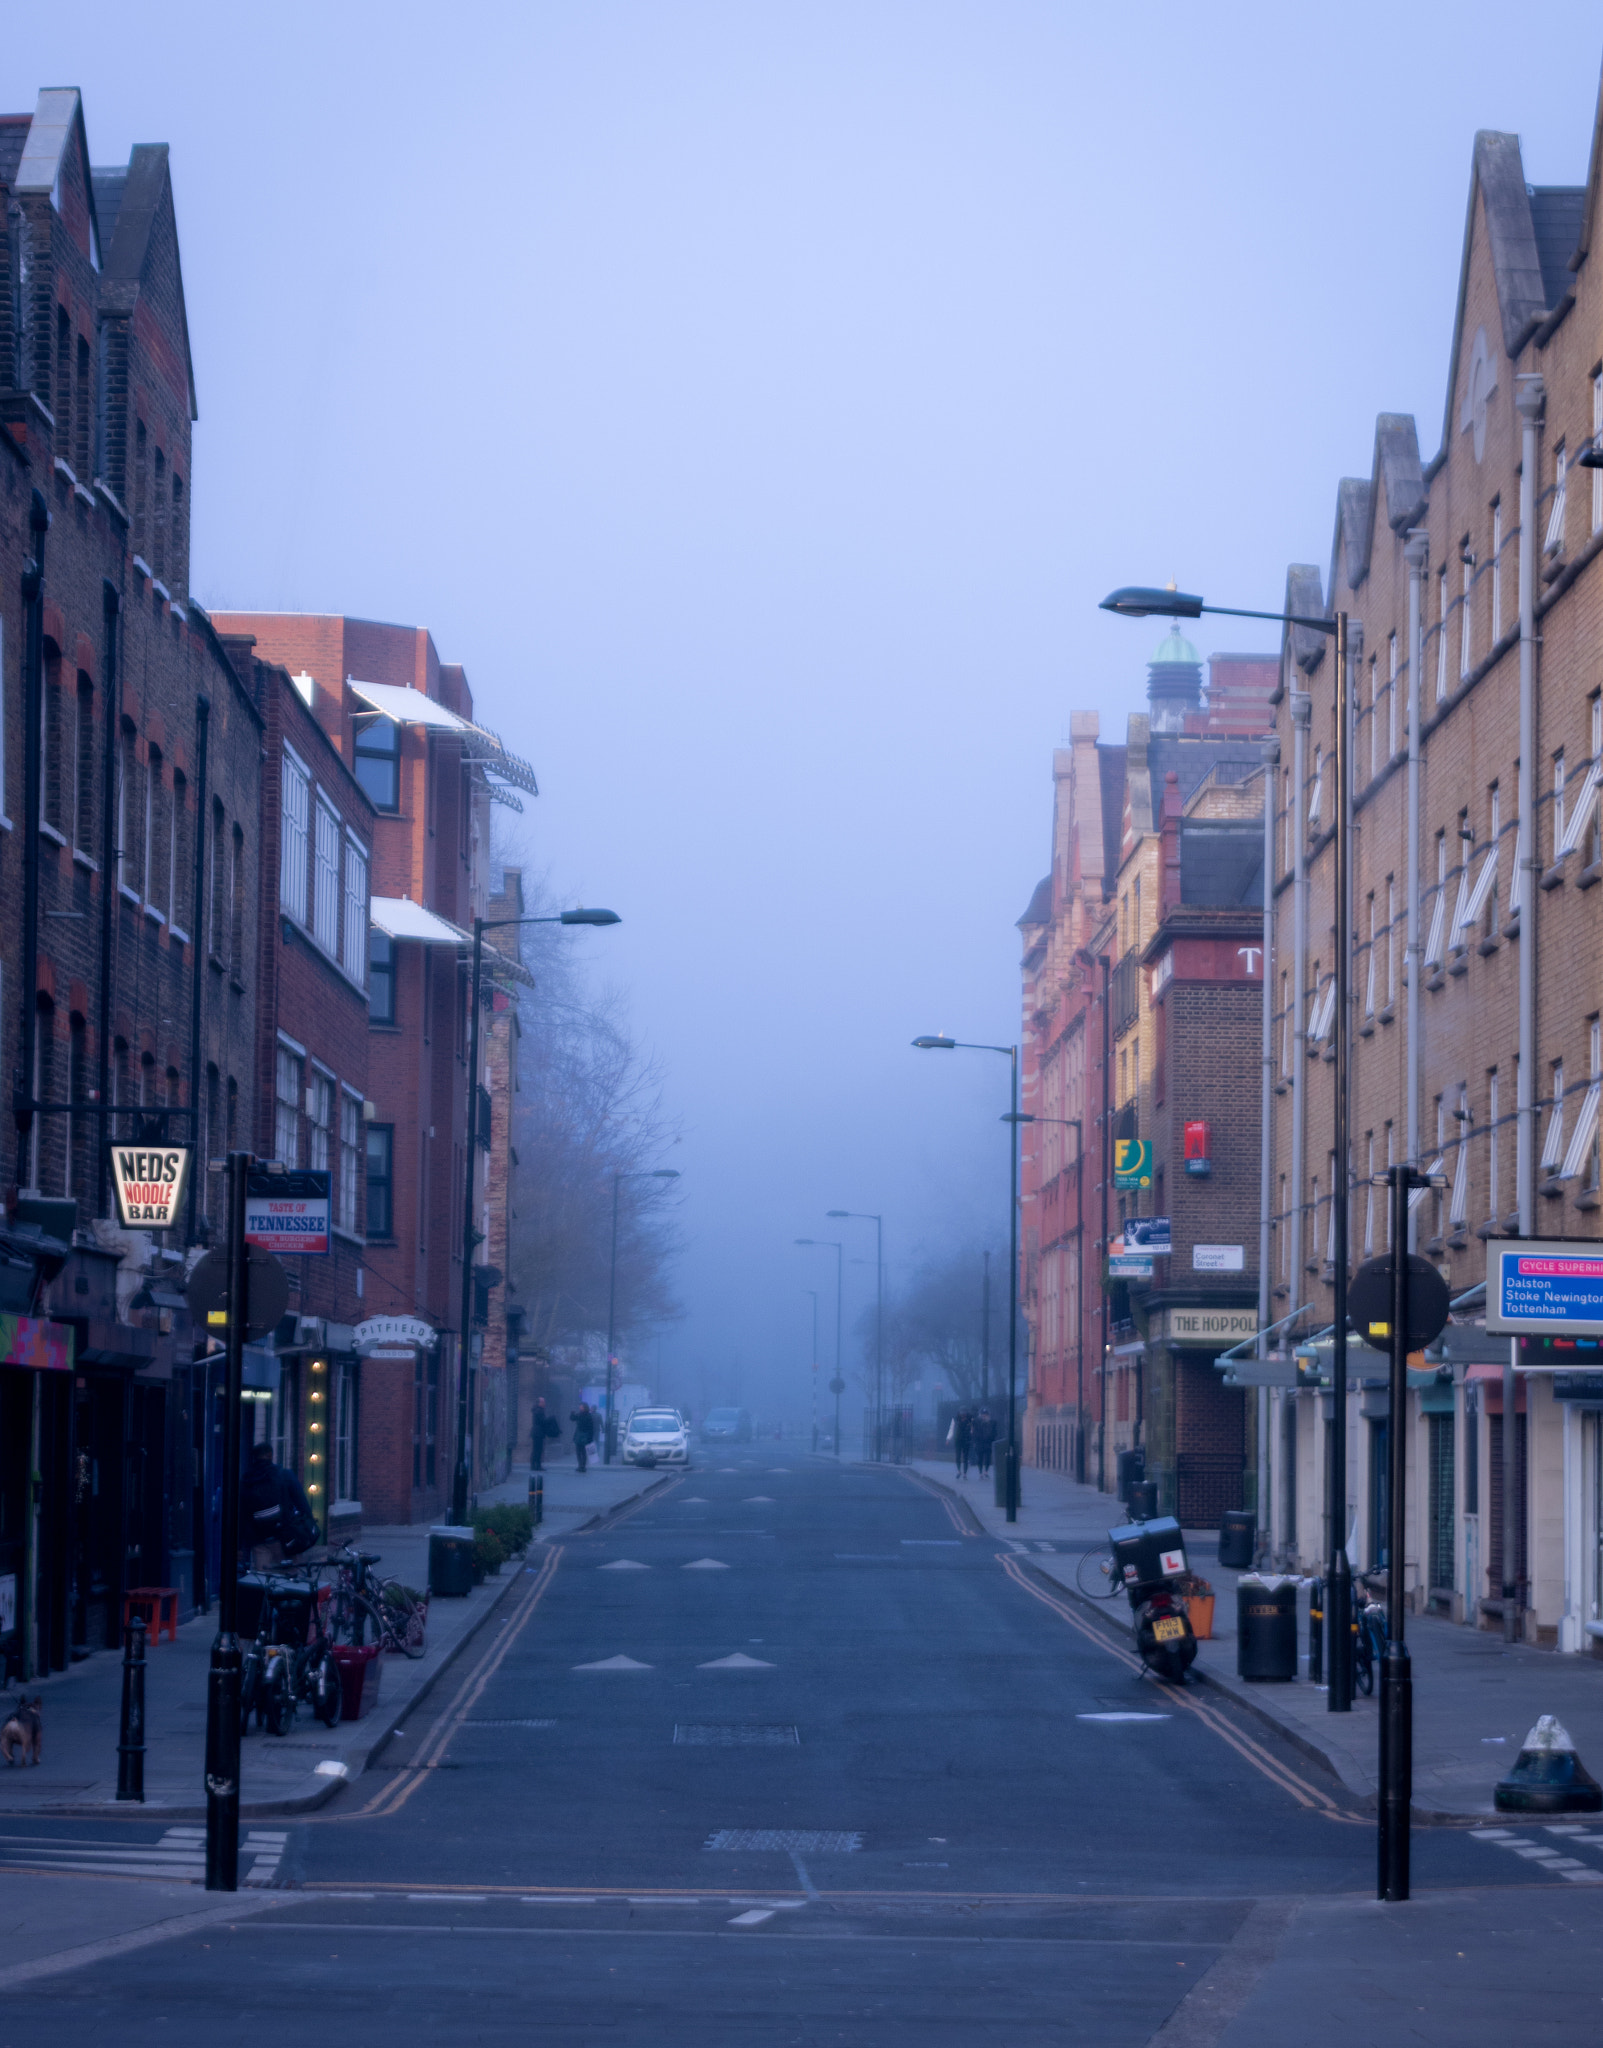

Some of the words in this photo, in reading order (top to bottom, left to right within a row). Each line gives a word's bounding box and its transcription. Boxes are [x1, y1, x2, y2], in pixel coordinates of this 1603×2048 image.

[118, 1151, 179, 1183] NEDS
[248, 1175, 326, 1193] OPEN
[123, 1182, 174, 1205] NOODLE
[127, 1204, 168, 1220] BAR
[268, 1202, 294, 1213] TASTE
[295, 1202, 307, 1213] OF
[248, 1215, 326, 1232] TENNESSEE
[279, 1235, 316, 1243] BURGERS
[1195, 1252, 1225, 1260] Coronet
[1195, 1259, 1218, 1267] Street
[1522, 1260, 1555, 1272] CYCLE
[1506, 1277, 1551, 1289] Dalston
[1505, 1290, 1540, 1301] Stoke
[1505, 1302, 1567, 1315] Tottenham
[360, 1323, 426, 1337] PITFIELD
[1174, 1315, 1200, 1332] THE
[1202, 1315, 1229, 1332] HOP
[1230, 1315, 1259, 1332] POL
[1165, 1556, 1179, 1569] L
